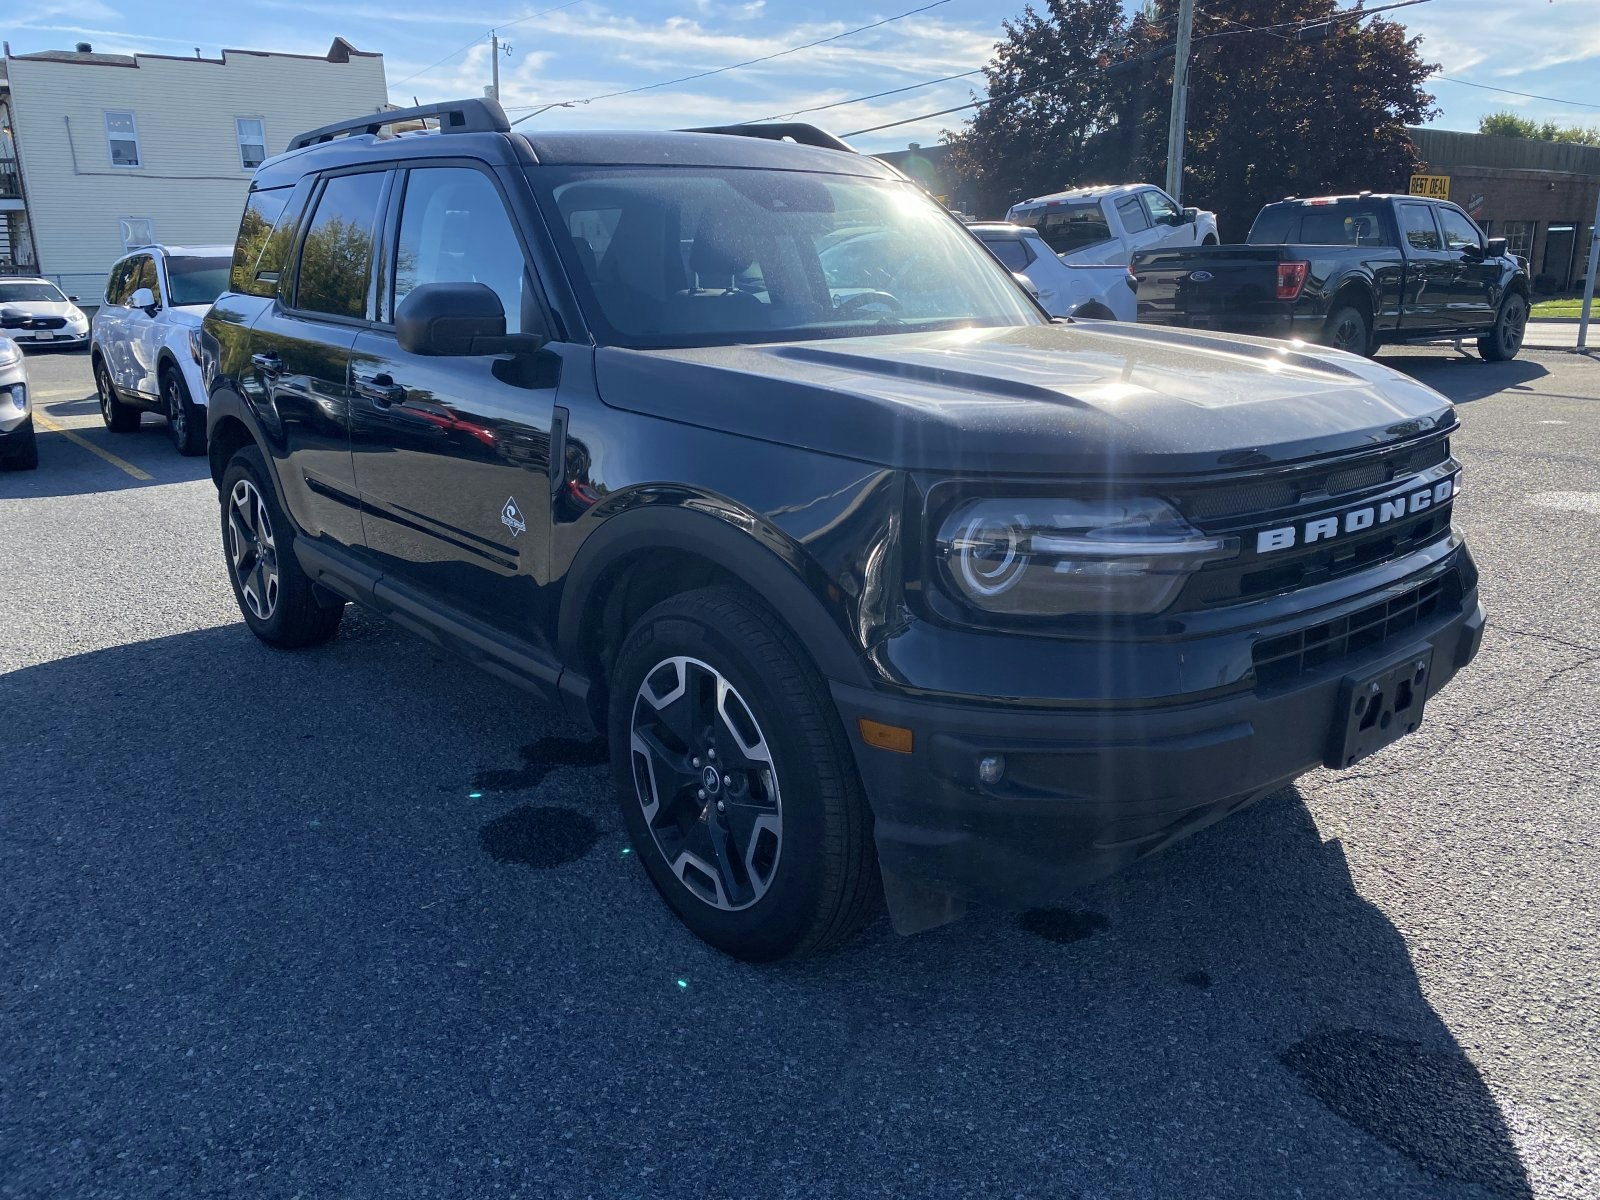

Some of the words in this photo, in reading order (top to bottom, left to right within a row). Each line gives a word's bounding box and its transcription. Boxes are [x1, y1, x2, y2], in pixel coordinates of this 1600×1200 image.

[1411, 177, 1428, 194] BEST
[1429, 178, 1447, 195] DEAL
[1256, 480, 1452, 554] BRONCO
